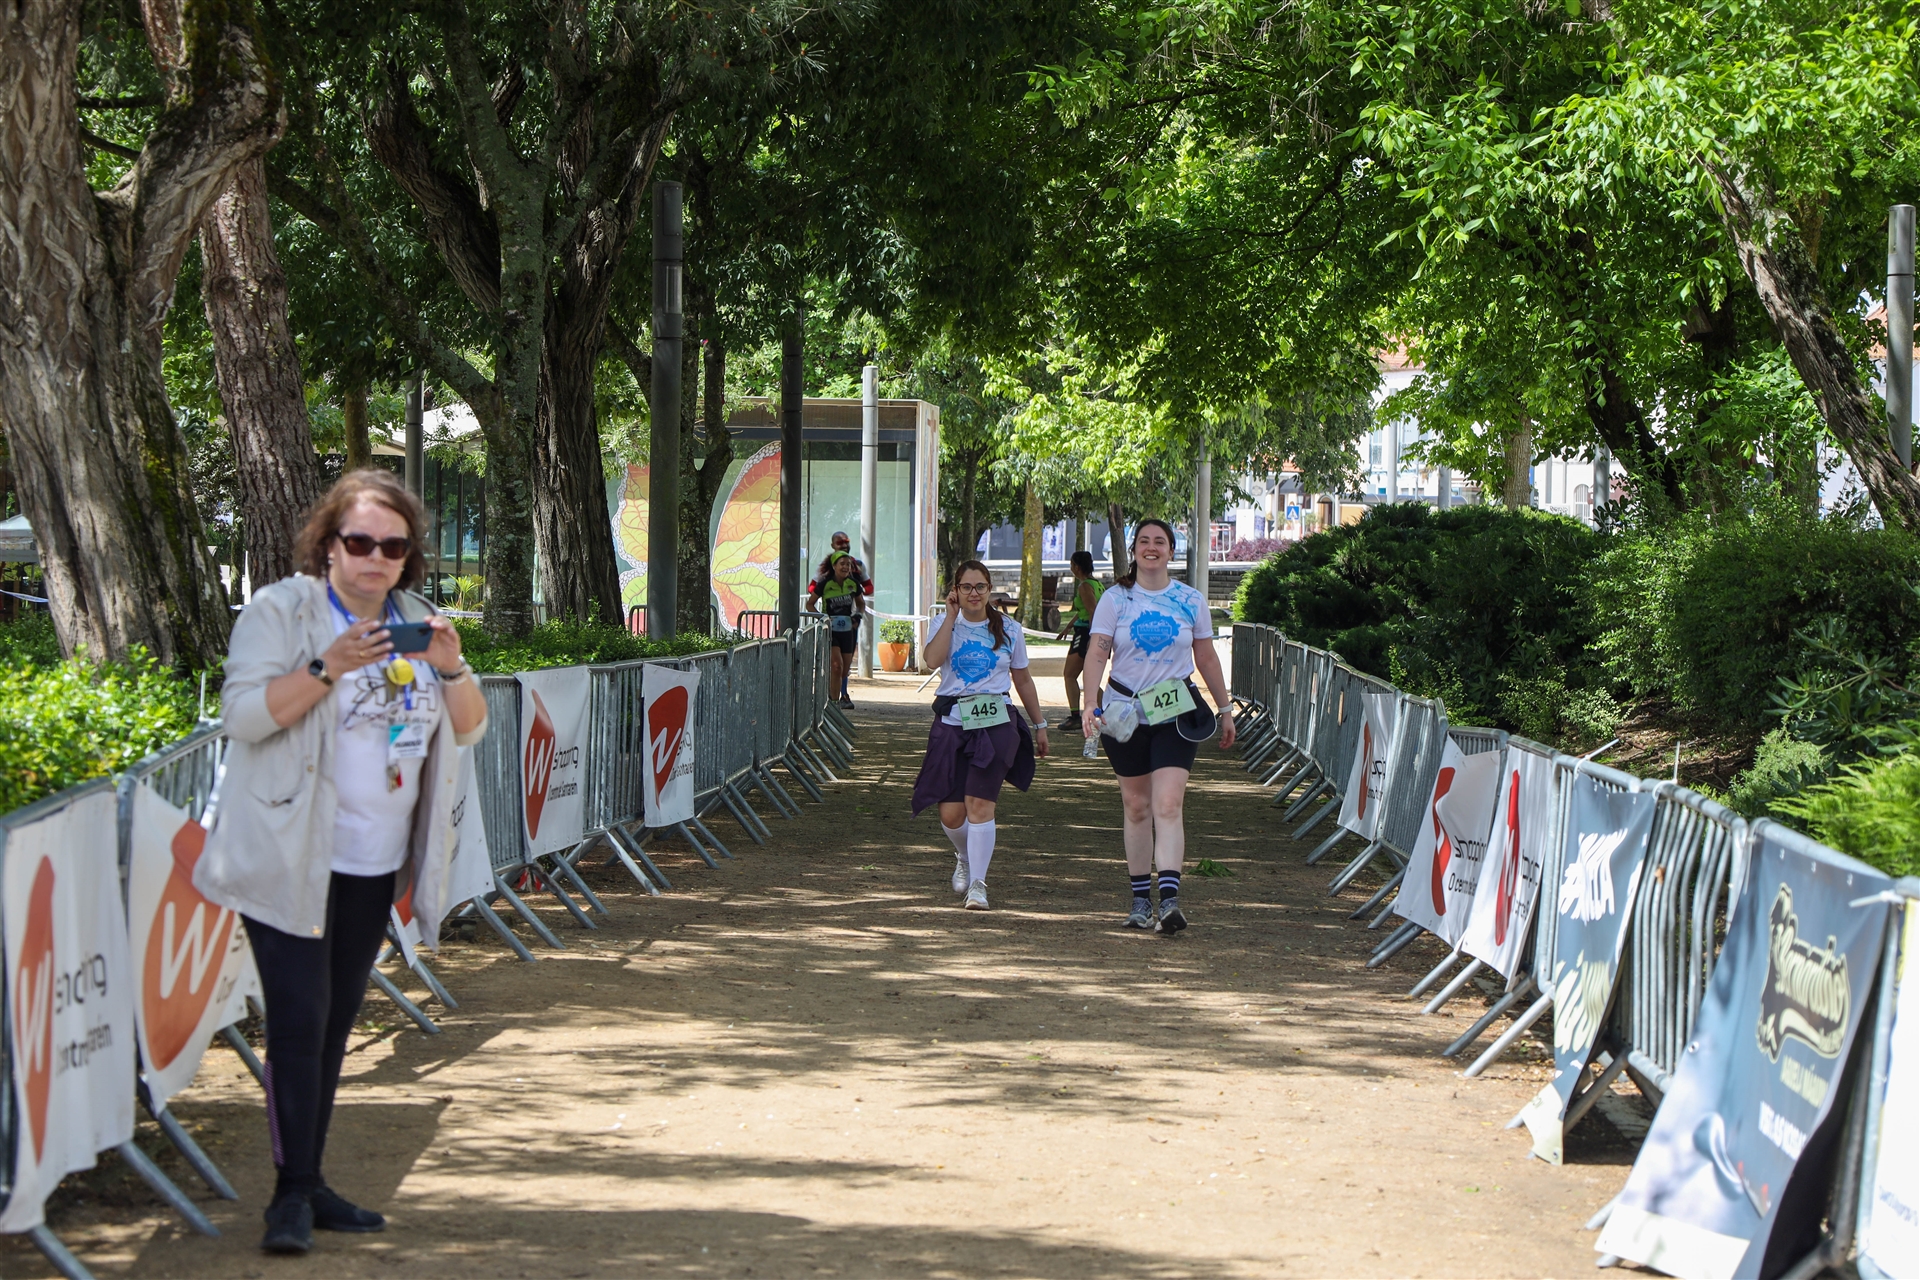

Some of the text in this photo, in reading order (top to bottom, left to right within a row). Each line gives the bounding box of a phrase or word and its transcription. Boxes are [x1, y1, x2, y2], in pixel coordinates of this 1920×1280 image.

[836, 620, 846, 628] 49
[1154, 689, 1179, 709] 427
[971, 702, 998, 717] 445
[528, 736, 554, 796] W
[160, 901, 229, 999] W
